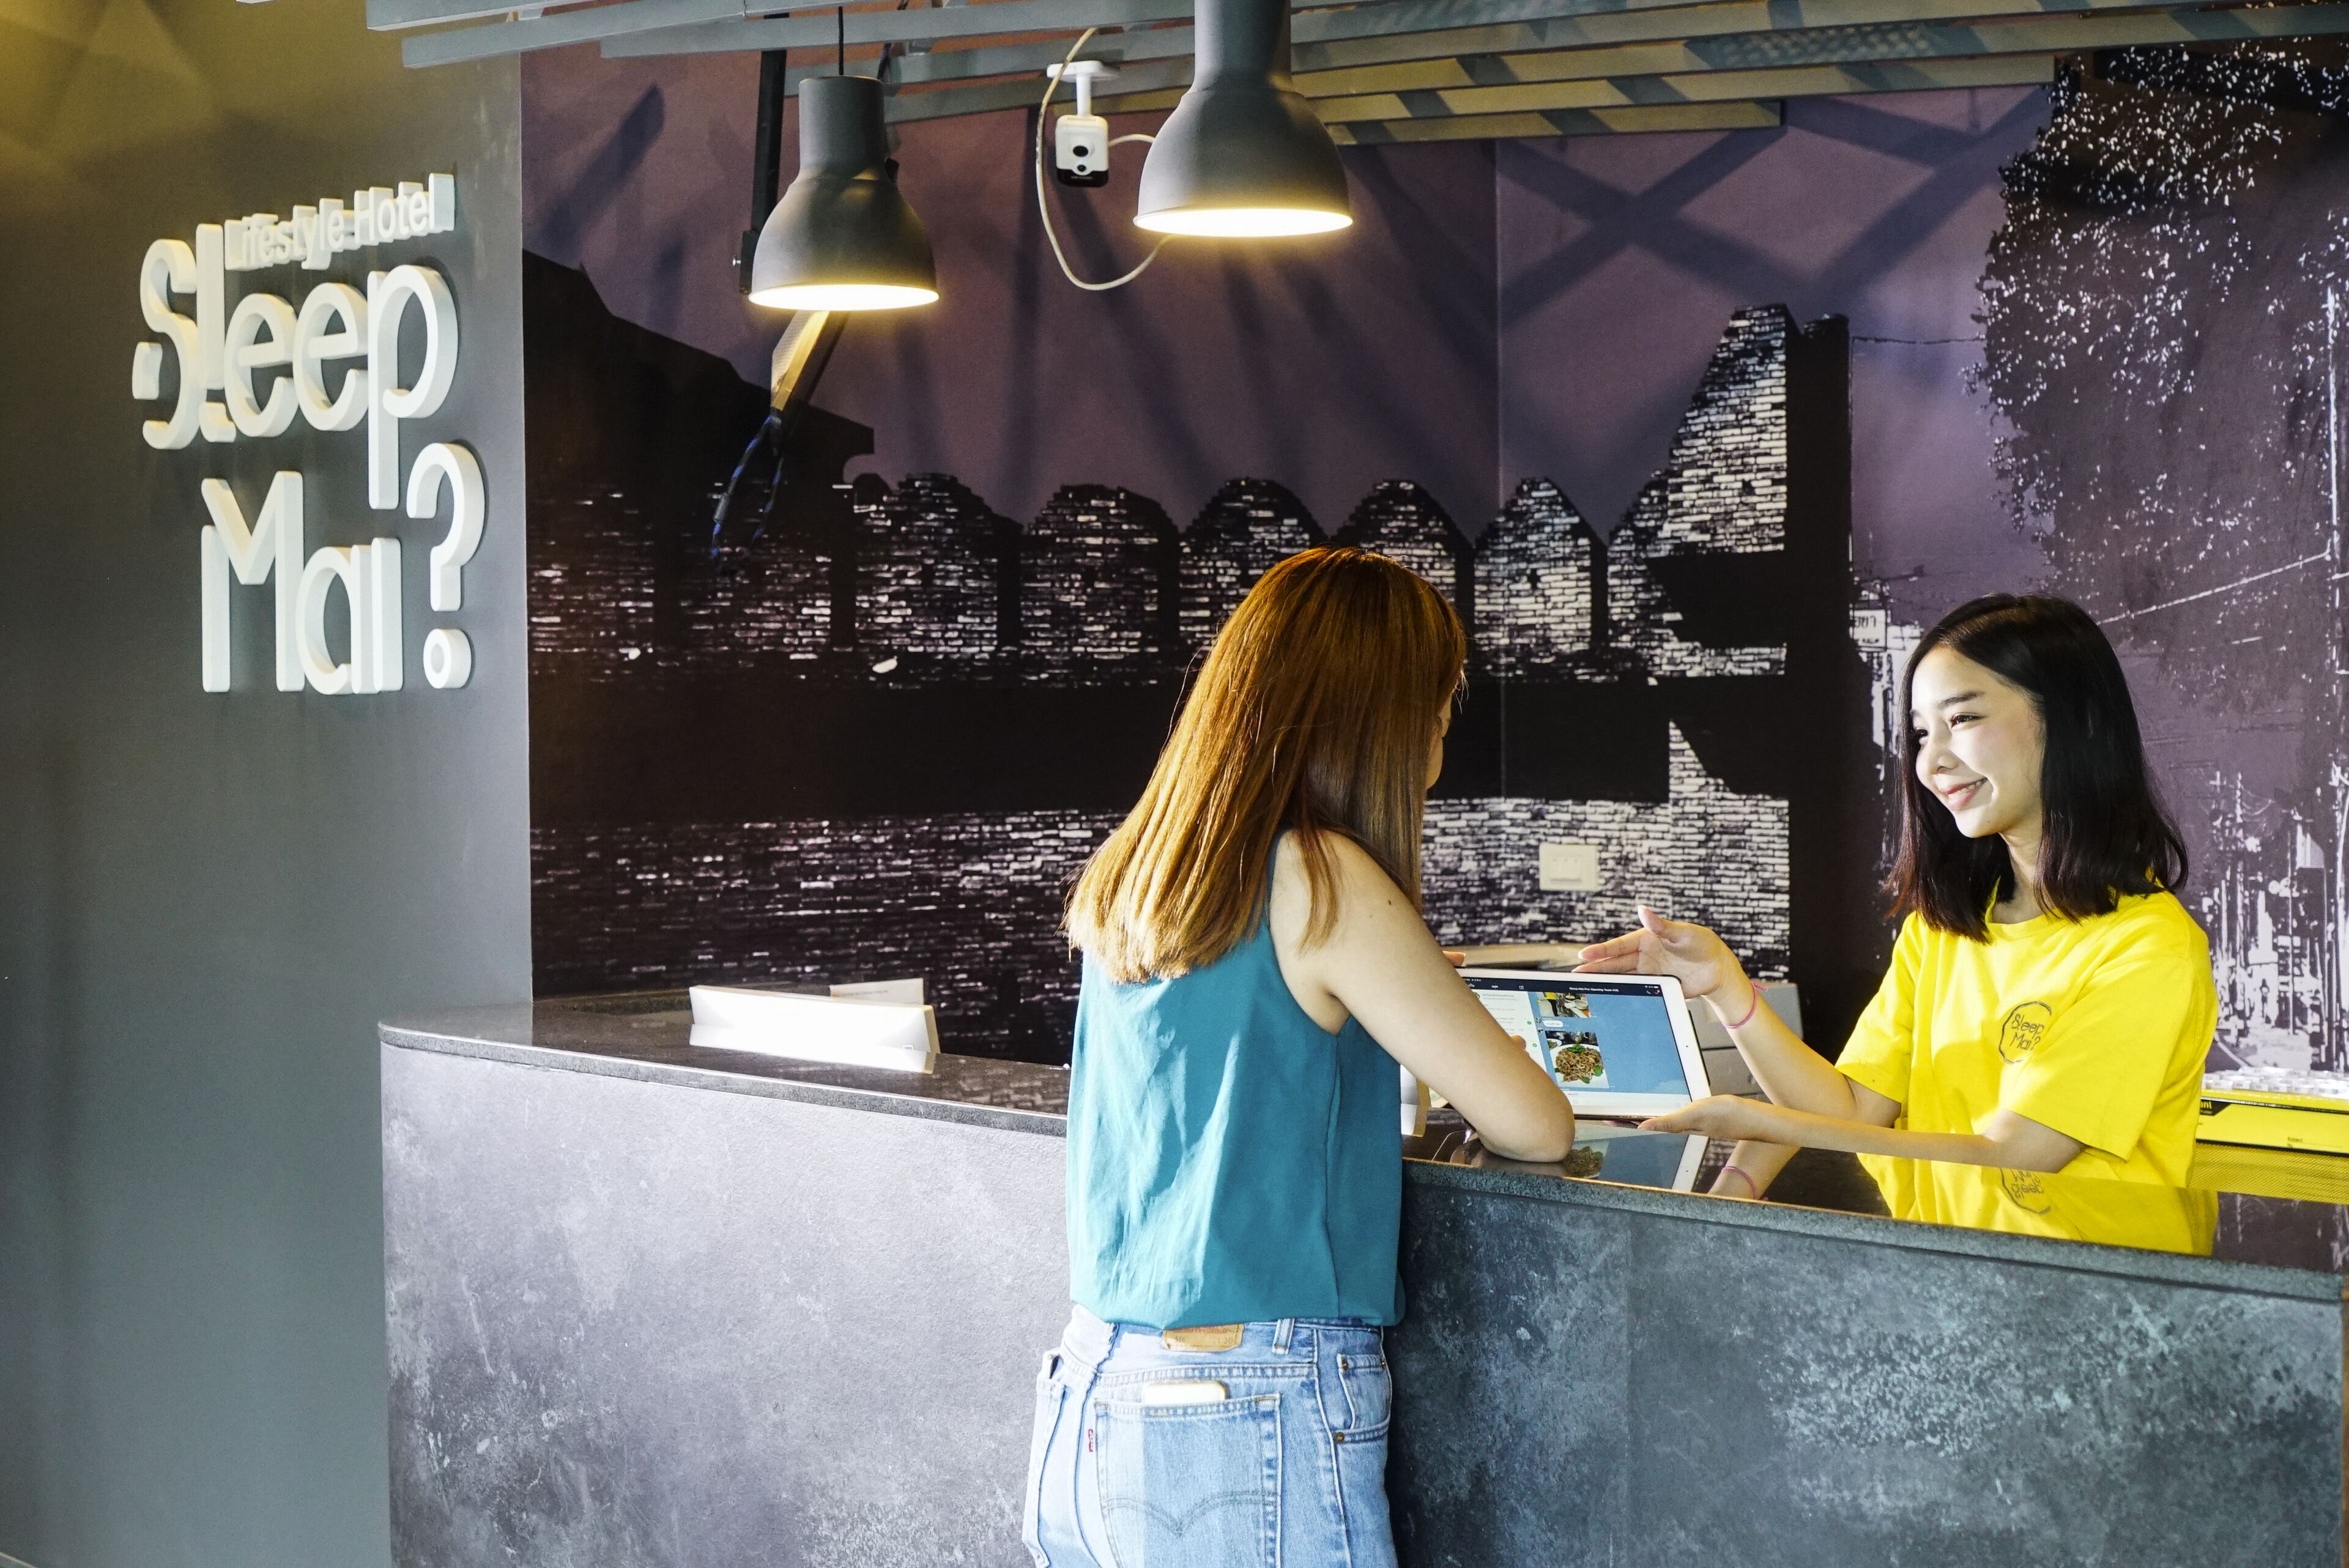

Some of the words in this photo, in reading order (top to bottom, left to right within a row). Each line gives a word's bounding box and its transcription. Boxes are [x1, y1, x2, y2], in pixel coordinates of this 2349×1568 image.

[225, 198, 355, 270] Lifestyle
[354, 173, 455, 246] Hotel
[133, 223, 459, 509] Sleep
[201, 443, 485, 694] Mai?
[2009, 1031, 2041, 1050] Mai?
[2011, 1013, 2044, 1039] Sleep
